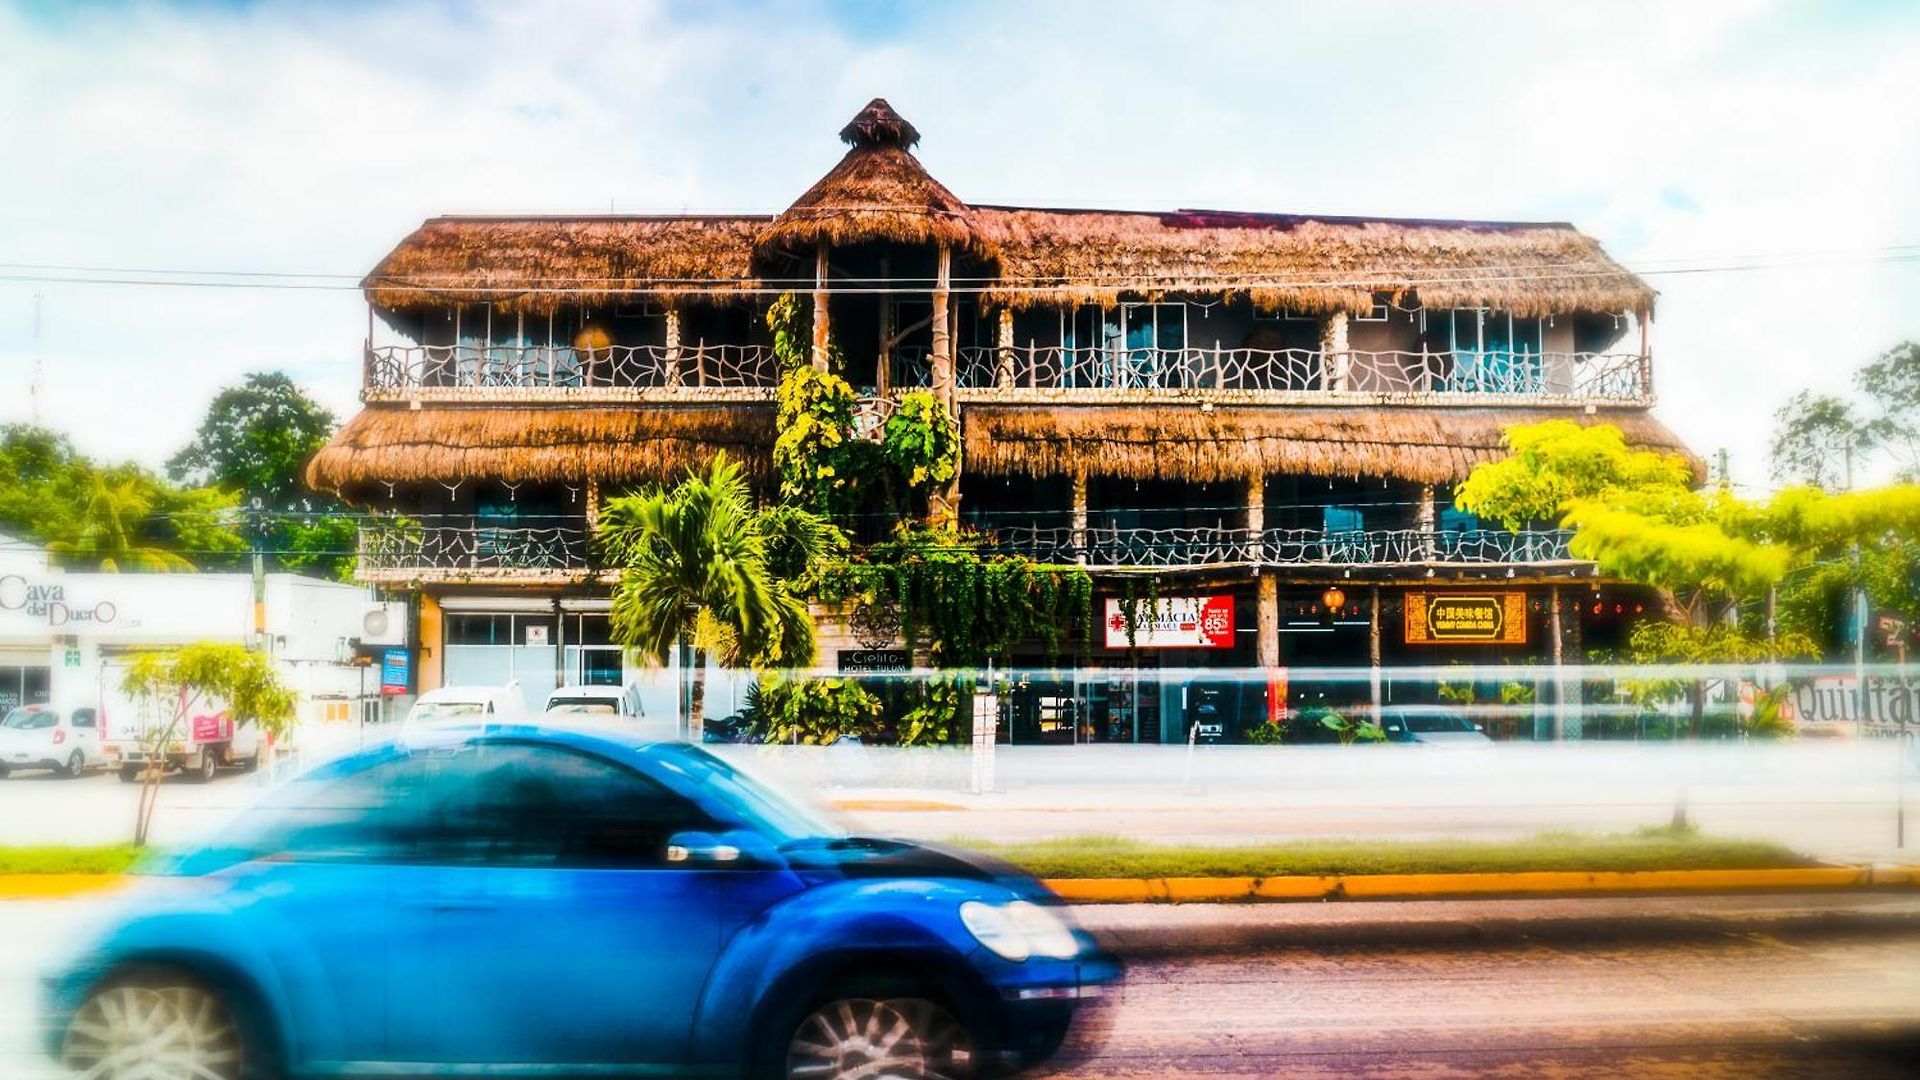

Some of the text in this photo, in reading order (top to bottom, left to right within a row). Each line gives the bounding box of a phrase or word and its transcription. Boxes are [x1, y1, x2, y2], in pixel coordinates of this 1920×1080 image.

[0, 574, 65, 610] Cava
[27, 602, 47, 616] del
[844, 664, 906, 673] HOTEL TULUM
